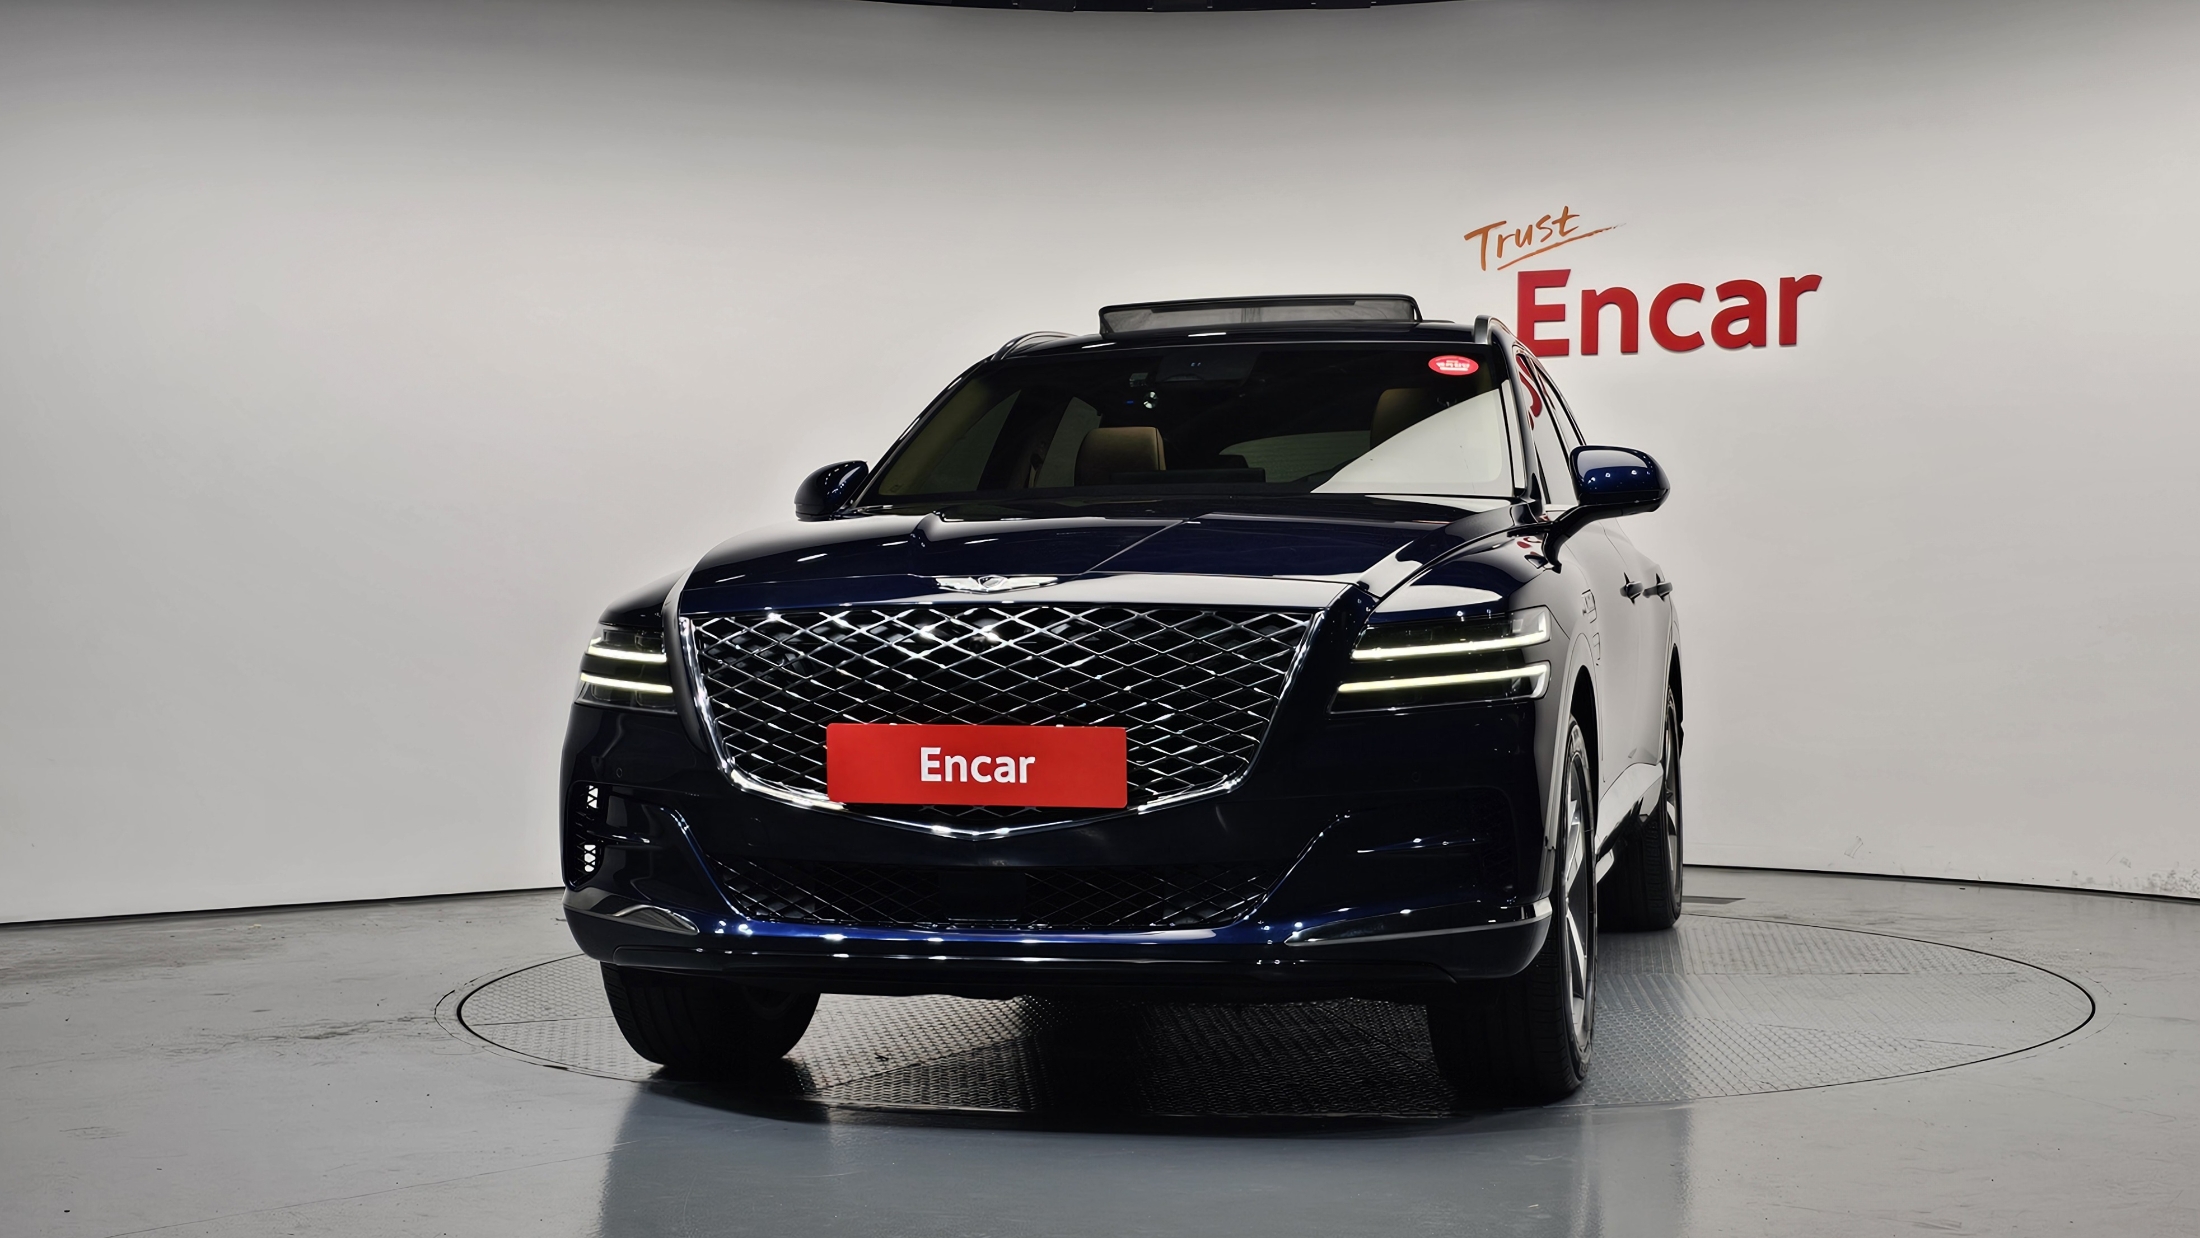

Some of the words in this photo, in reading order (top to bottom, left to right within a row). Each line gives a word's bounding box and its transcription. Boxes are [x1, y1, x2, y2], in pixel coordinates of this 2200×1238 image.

[1464, 206, 1580, 271] Trust
[1517, 269, 1822, 357] Encar
[920, 746, 1036, 784] Encar
